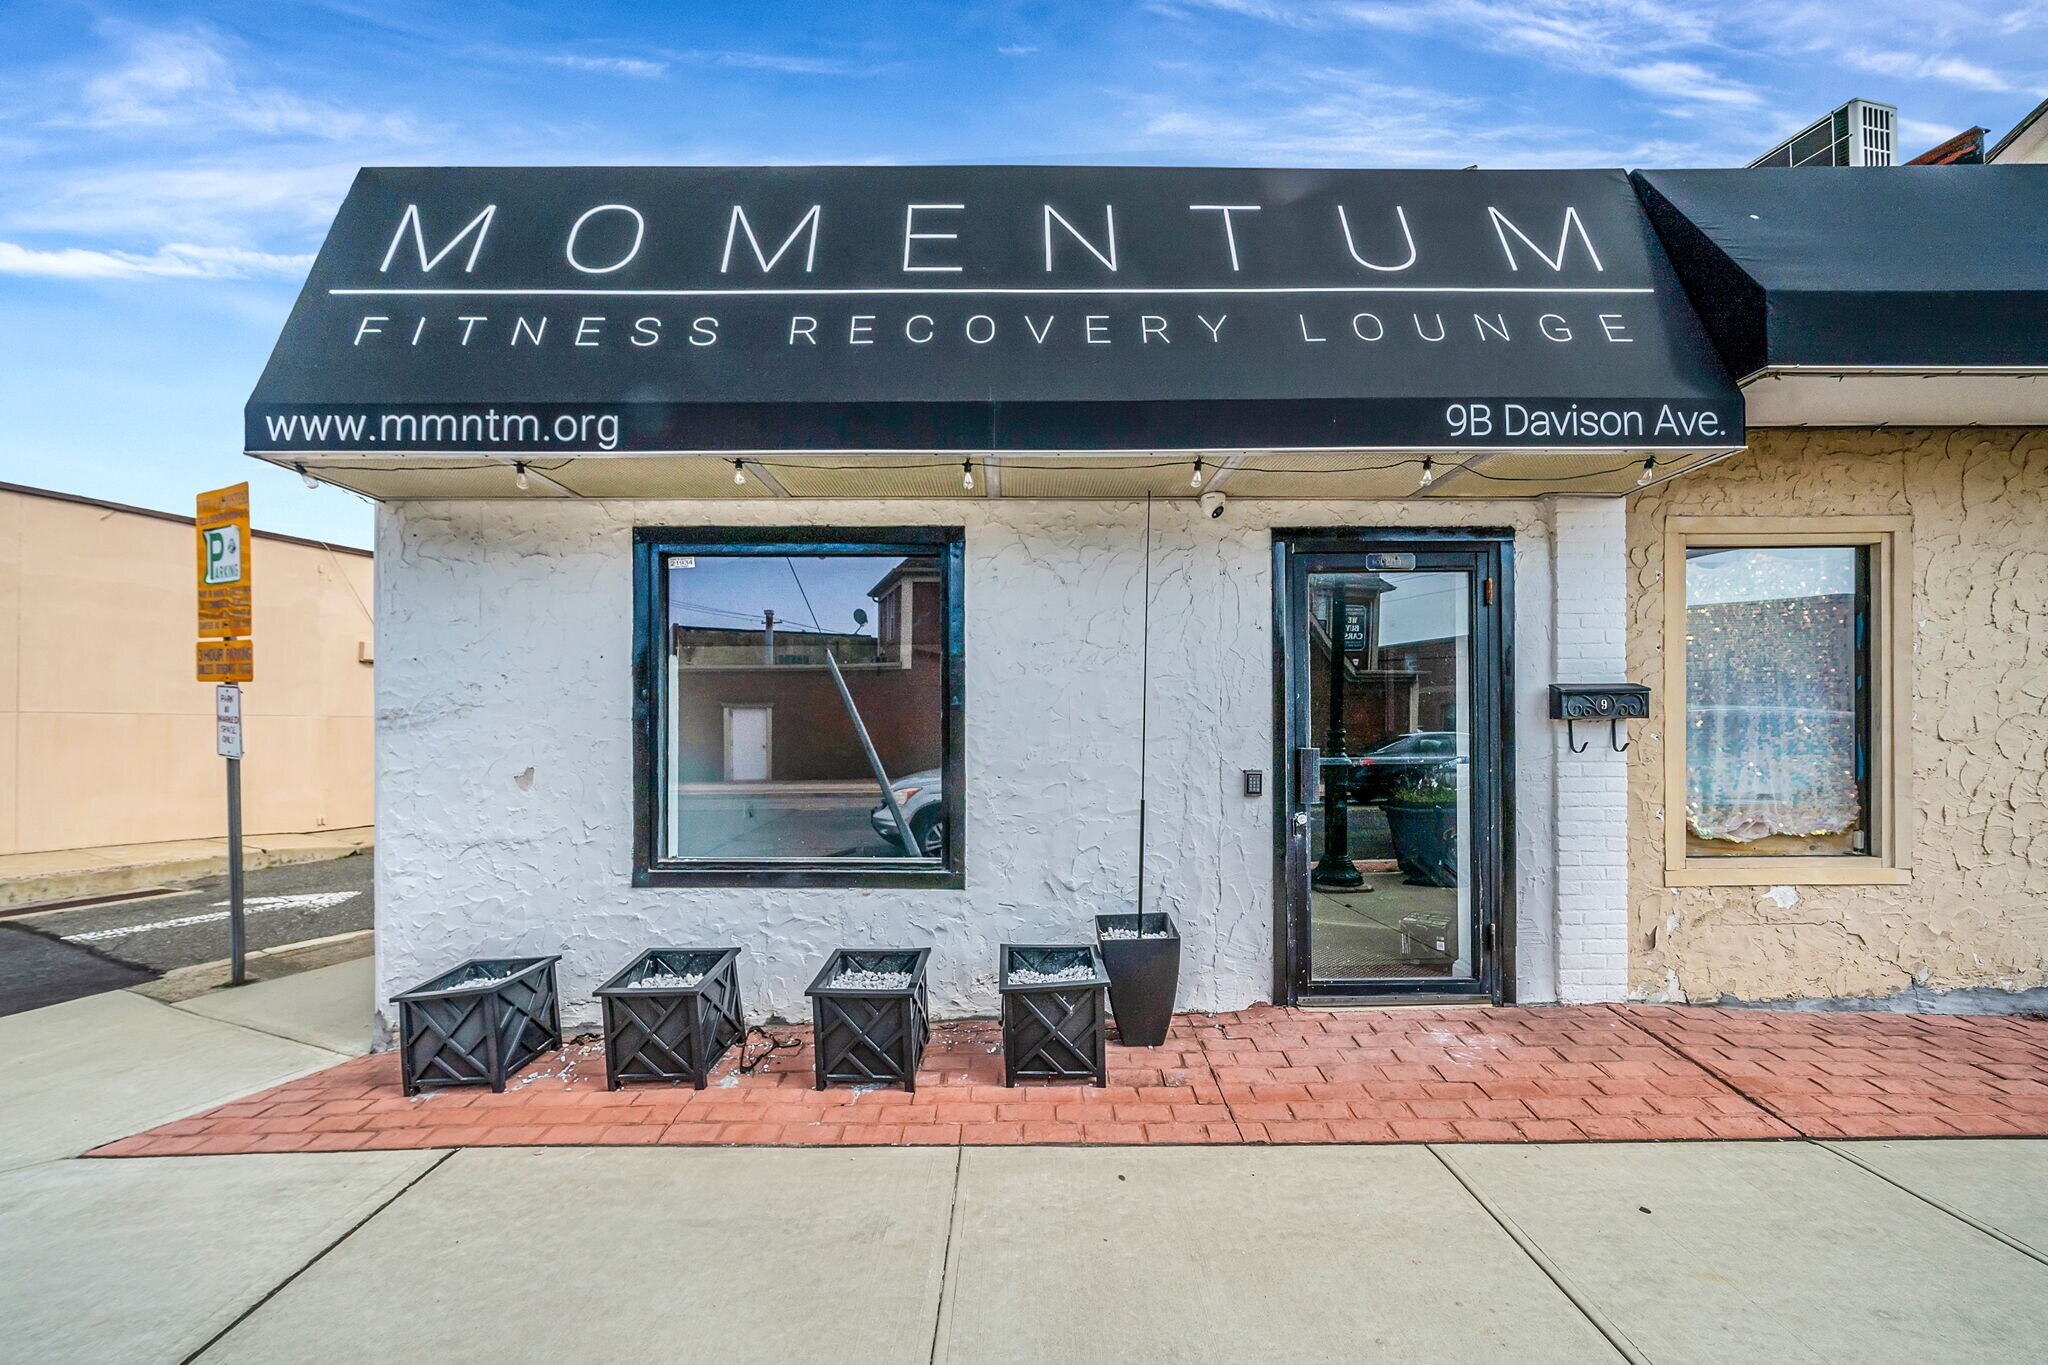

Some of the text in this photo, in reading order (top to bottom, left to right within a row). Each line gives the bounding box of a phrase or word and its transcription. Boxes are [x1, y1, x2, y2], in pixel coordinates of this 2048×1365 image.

[379, 203, 1604, 274] MOMENTUM
[353, 312, 1634, 347] FITNESS RECOVERY LOUNGE
[265, 409, 619, 450] www.mmntm.org
[1446, 403, 1727, 437] 9B Davison Ave.
[1600, 699, 1608, 710] 9
